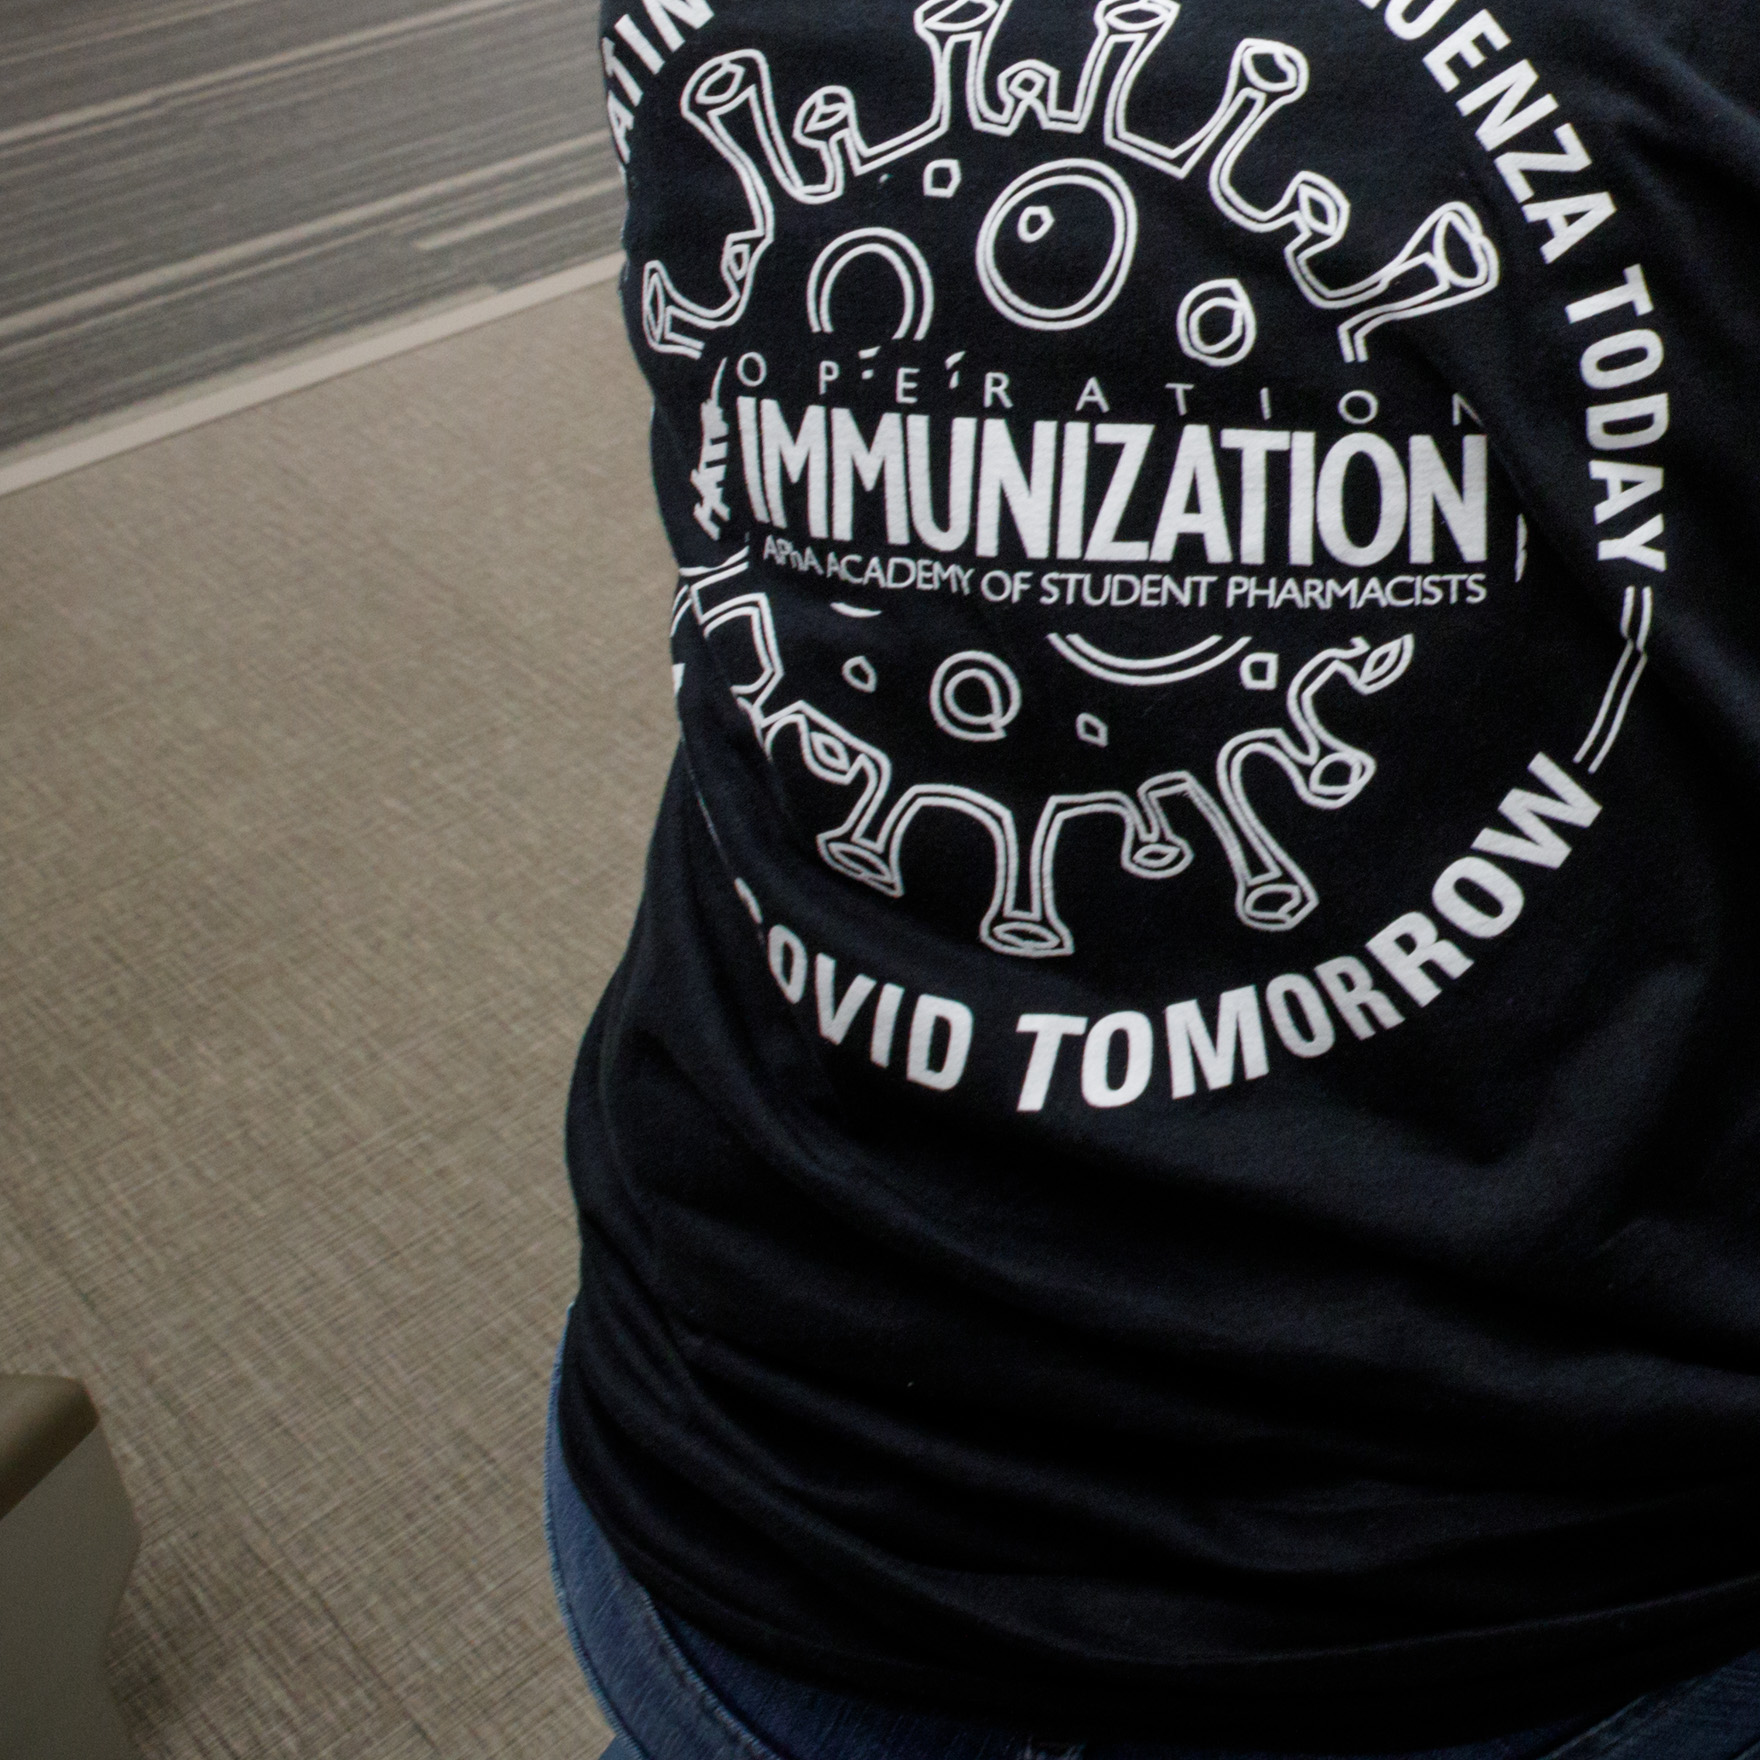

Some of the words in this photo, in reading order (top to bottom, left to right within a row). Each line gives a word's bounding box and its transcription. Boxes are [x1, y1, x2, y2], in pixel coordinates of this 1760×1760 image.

[736, 395, 1488, 568] IMMUNIZATION
[1564, 263, 1670, 572] TODAY
[826, 551, 974, 597] ACADEMY
[980, 570, 1034, 604] OF
[1039, 573, 1218, 608] STUDENT
[1227, 572, 1488, 611] PHARMACISTS
[750, 900, 973, 1092] OVID
[1015, 751, 1602, 1112] TOMORROW
